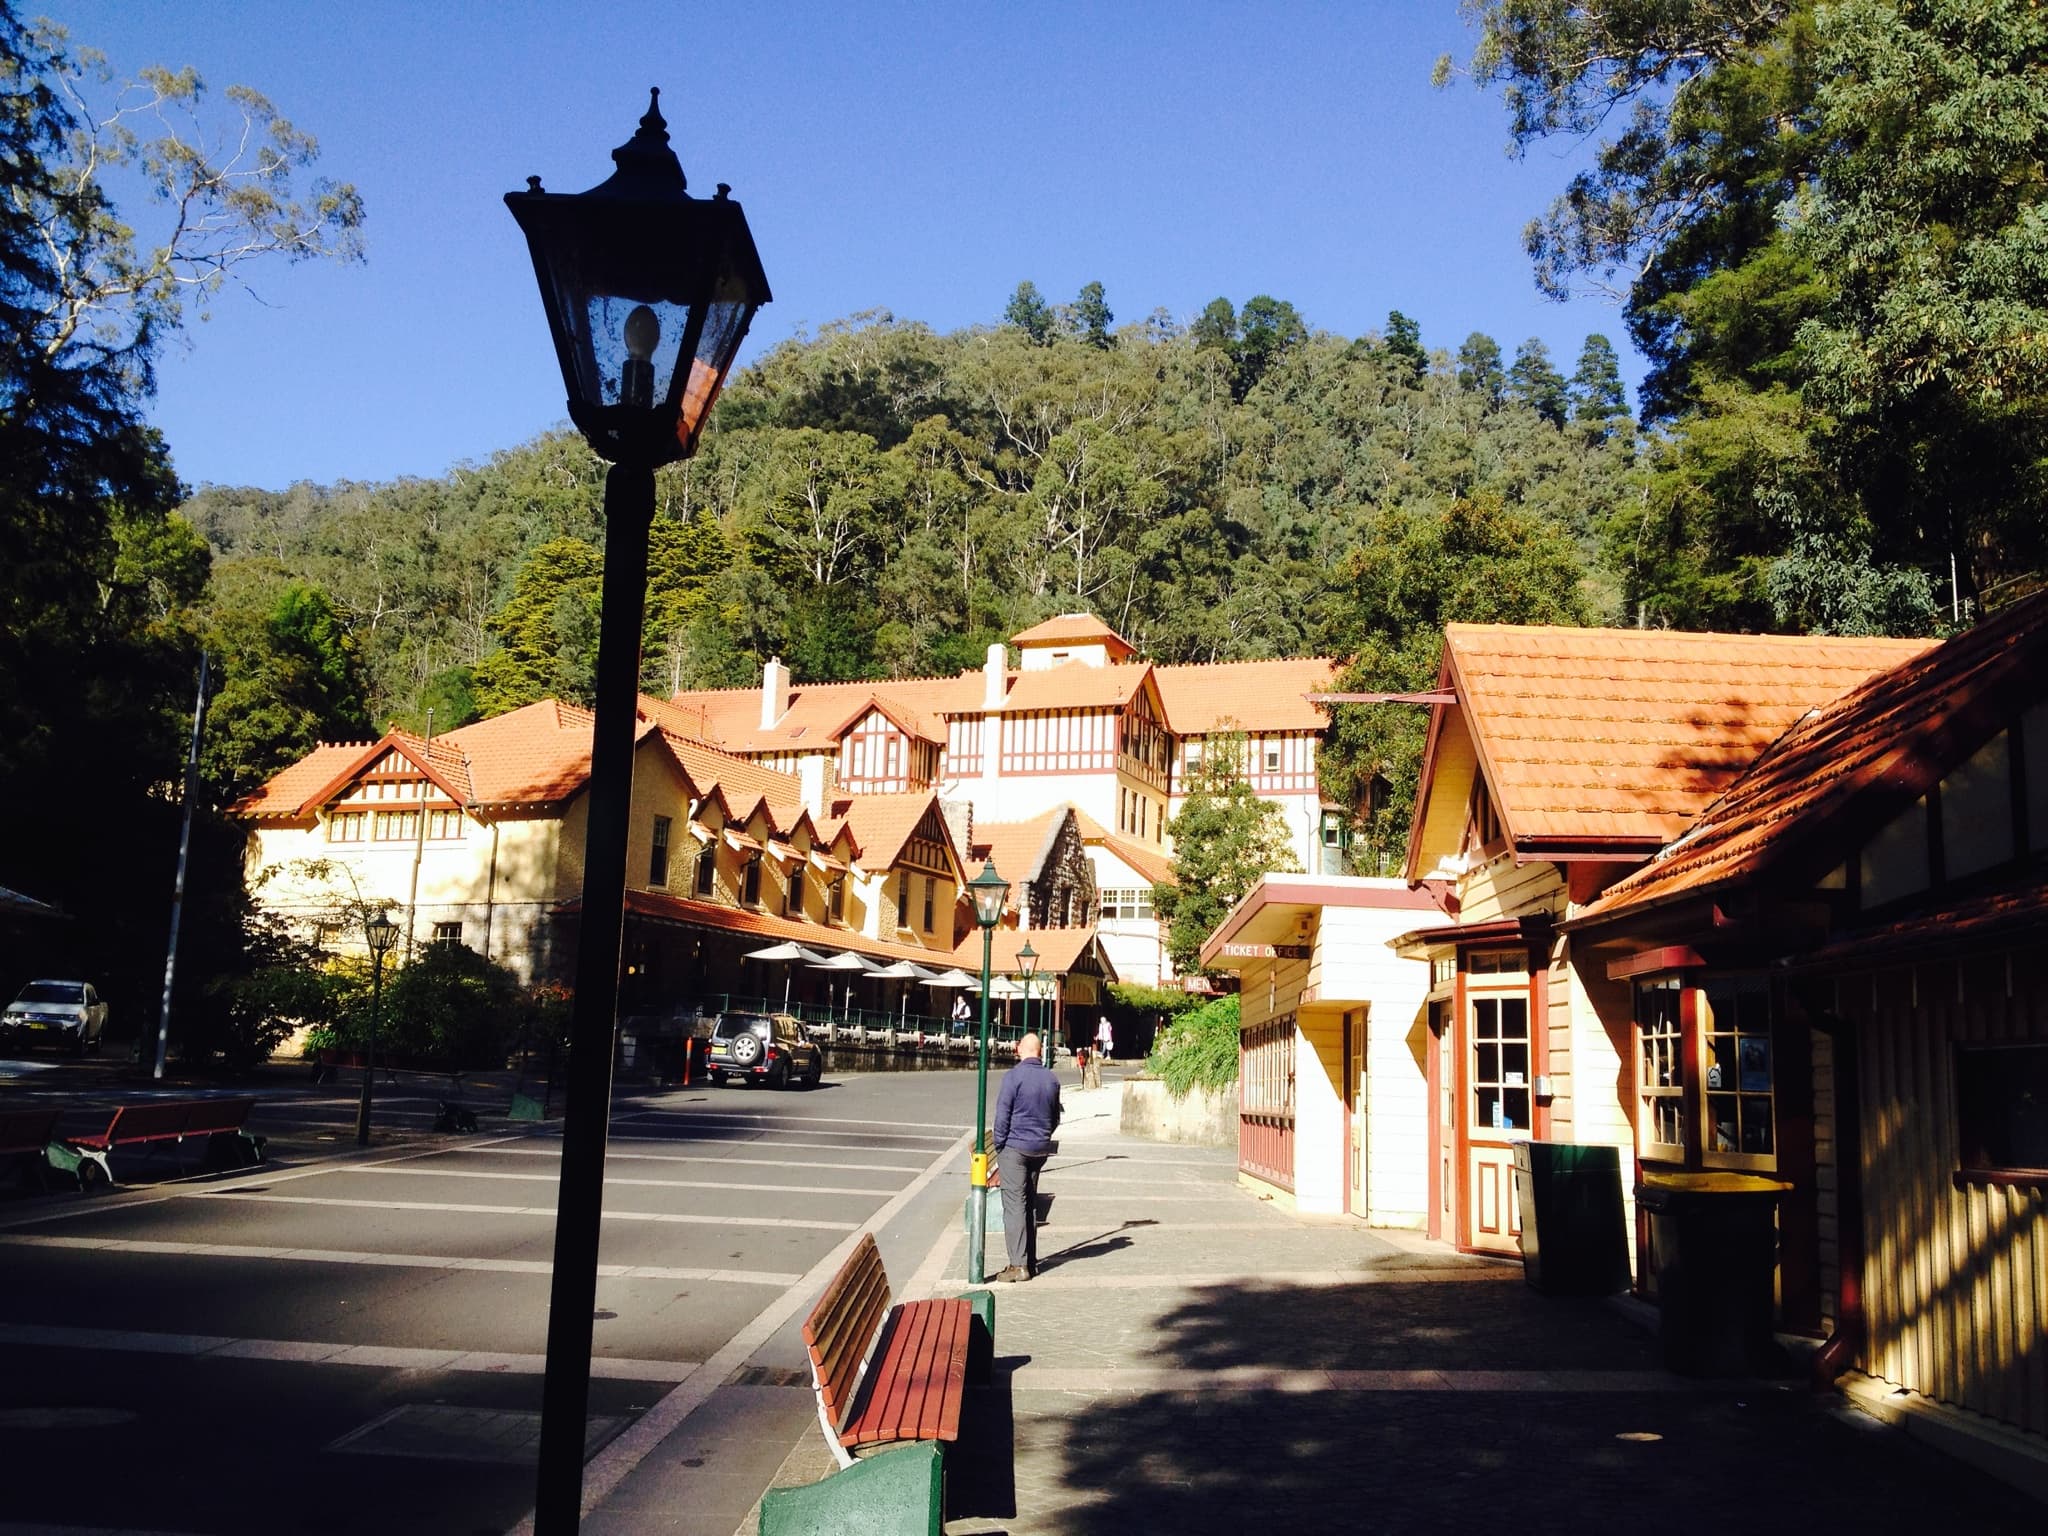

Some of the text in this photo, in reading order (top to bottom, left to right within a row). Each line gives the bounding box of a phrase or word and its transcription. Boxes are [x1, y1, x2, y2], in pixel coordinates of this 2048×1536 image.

[1224, 944, 1300, 958] TICKET OFFICE
[1187, 978, 1210, 991] MEN
